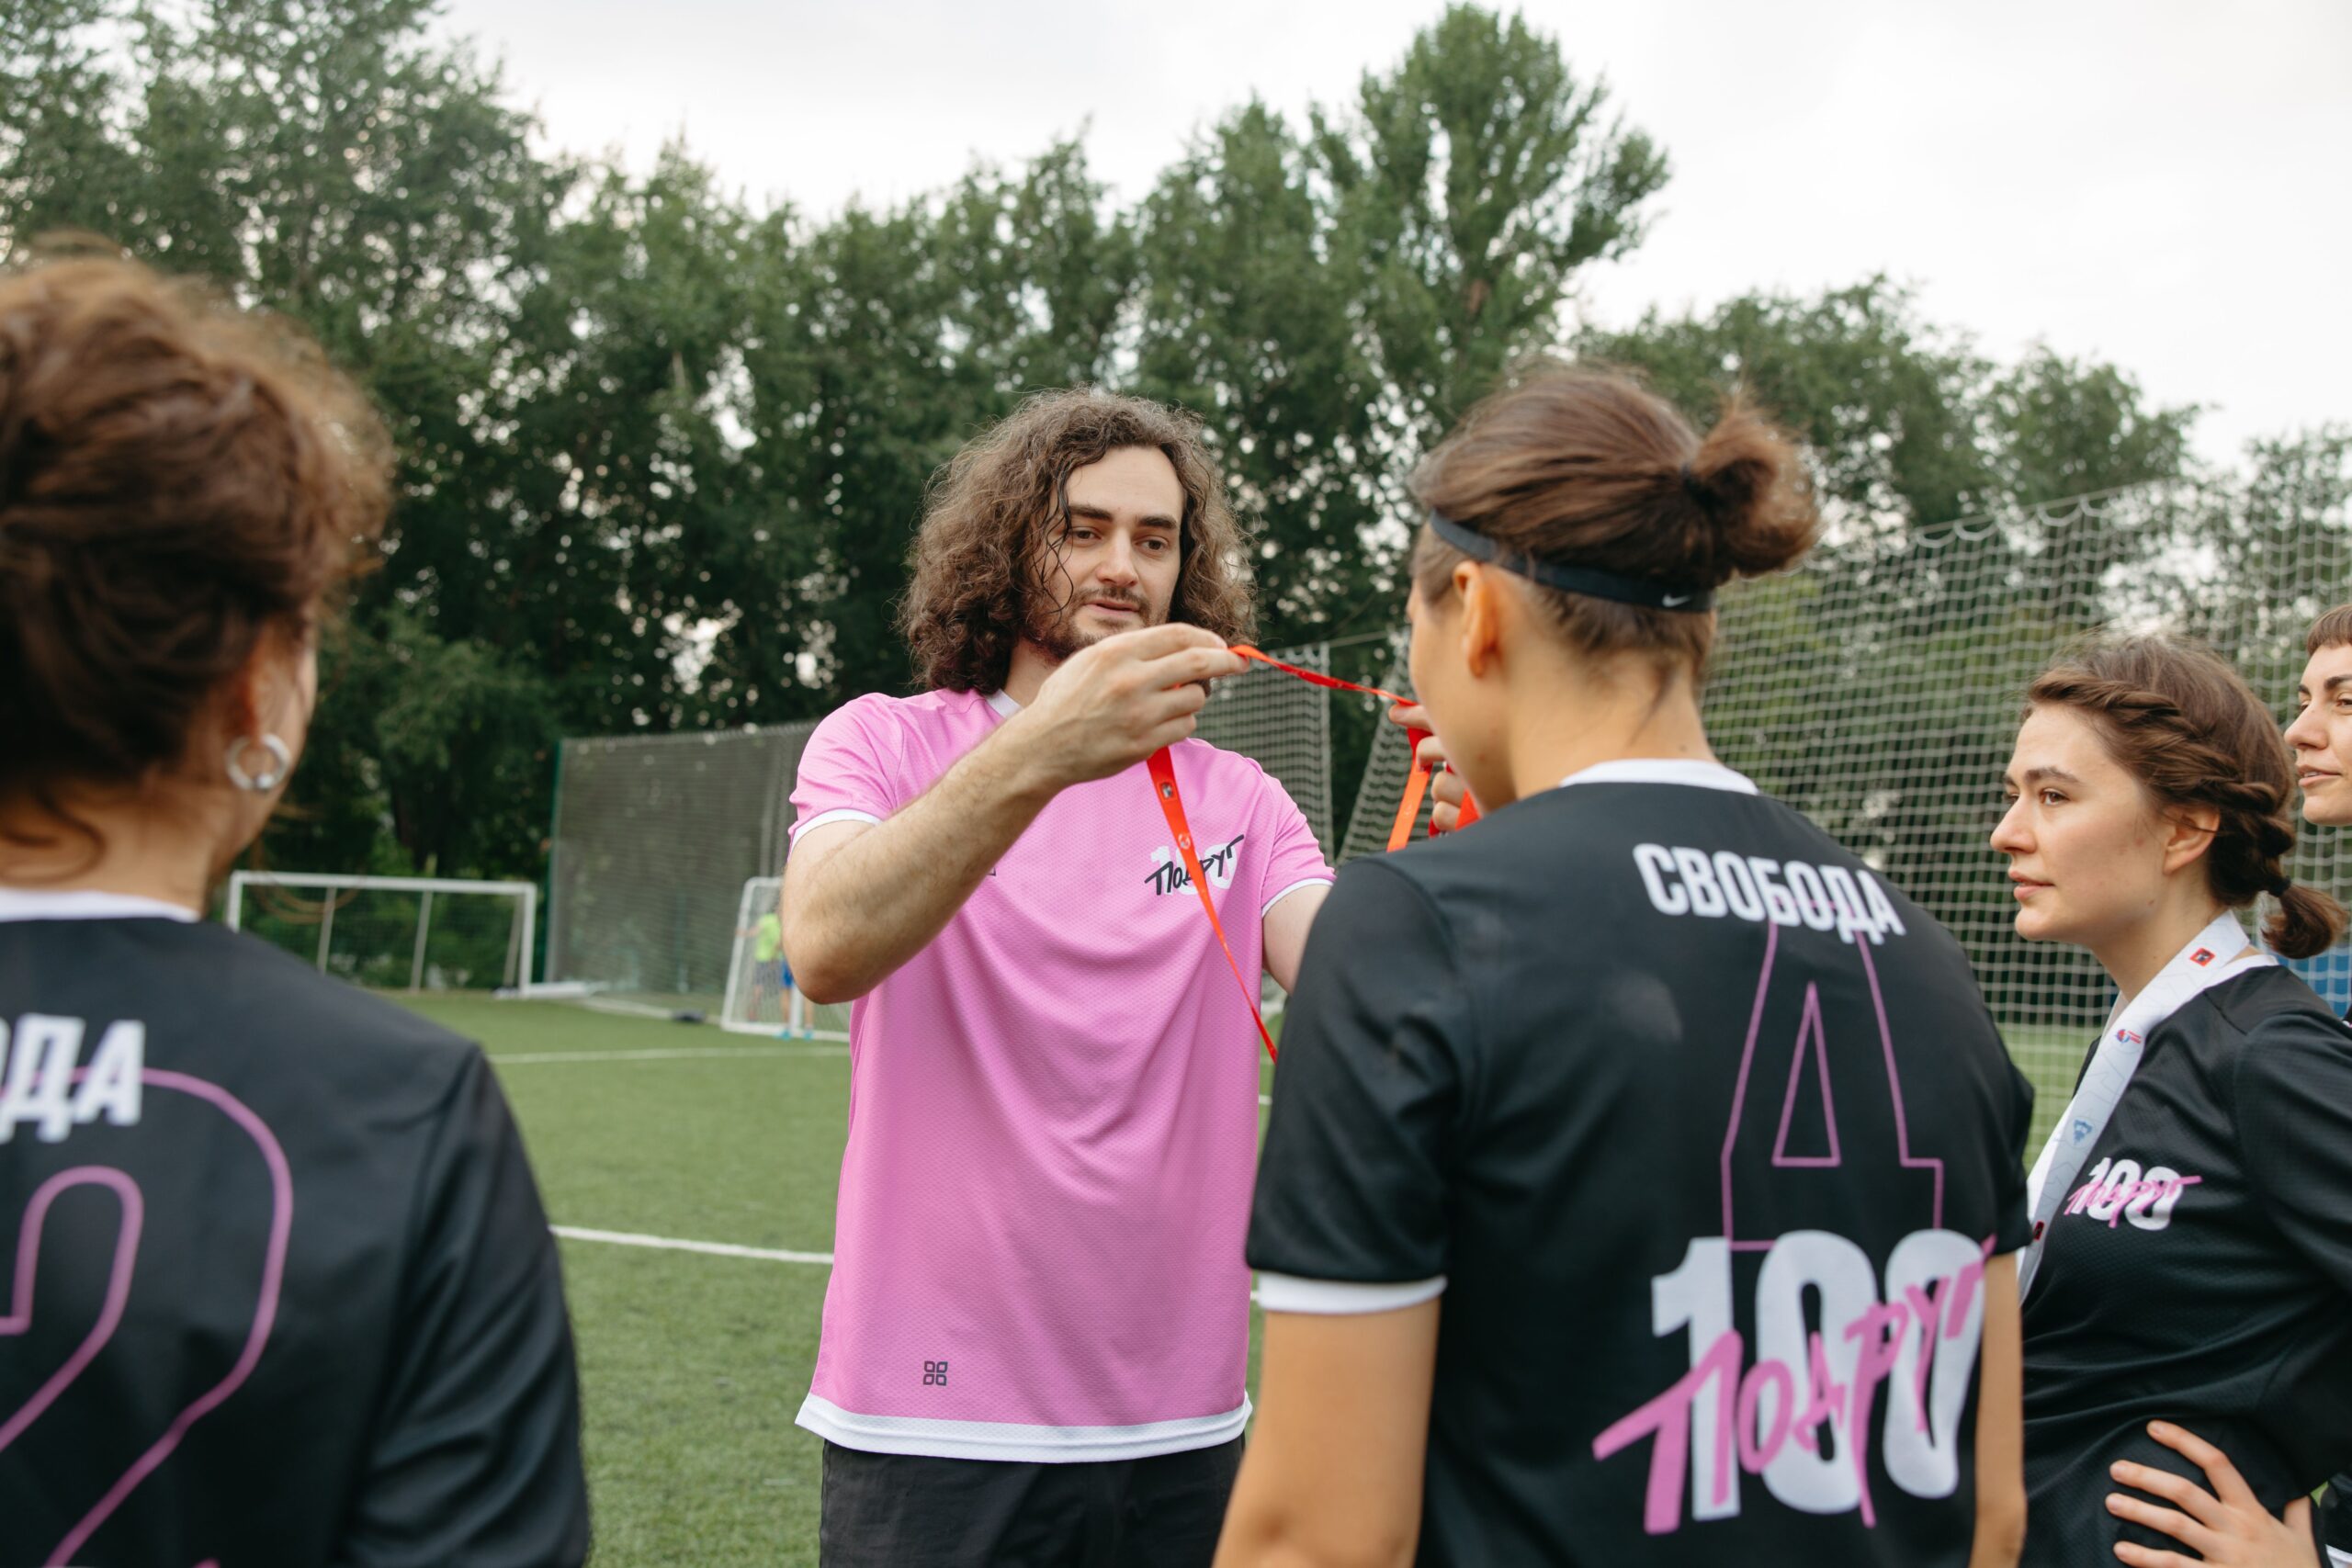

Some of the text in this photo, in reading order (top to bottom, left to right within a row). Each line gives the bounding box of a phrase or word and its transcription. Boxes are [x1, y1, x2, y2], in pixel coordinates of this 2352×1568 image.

[1633, 842, 1907, 946] СВОБОДА
[0, 1011, 146, 1145] ДА
[2069, 1156, 2184, 1231] 100
[1652, 1228, 1985, 1522] 100
